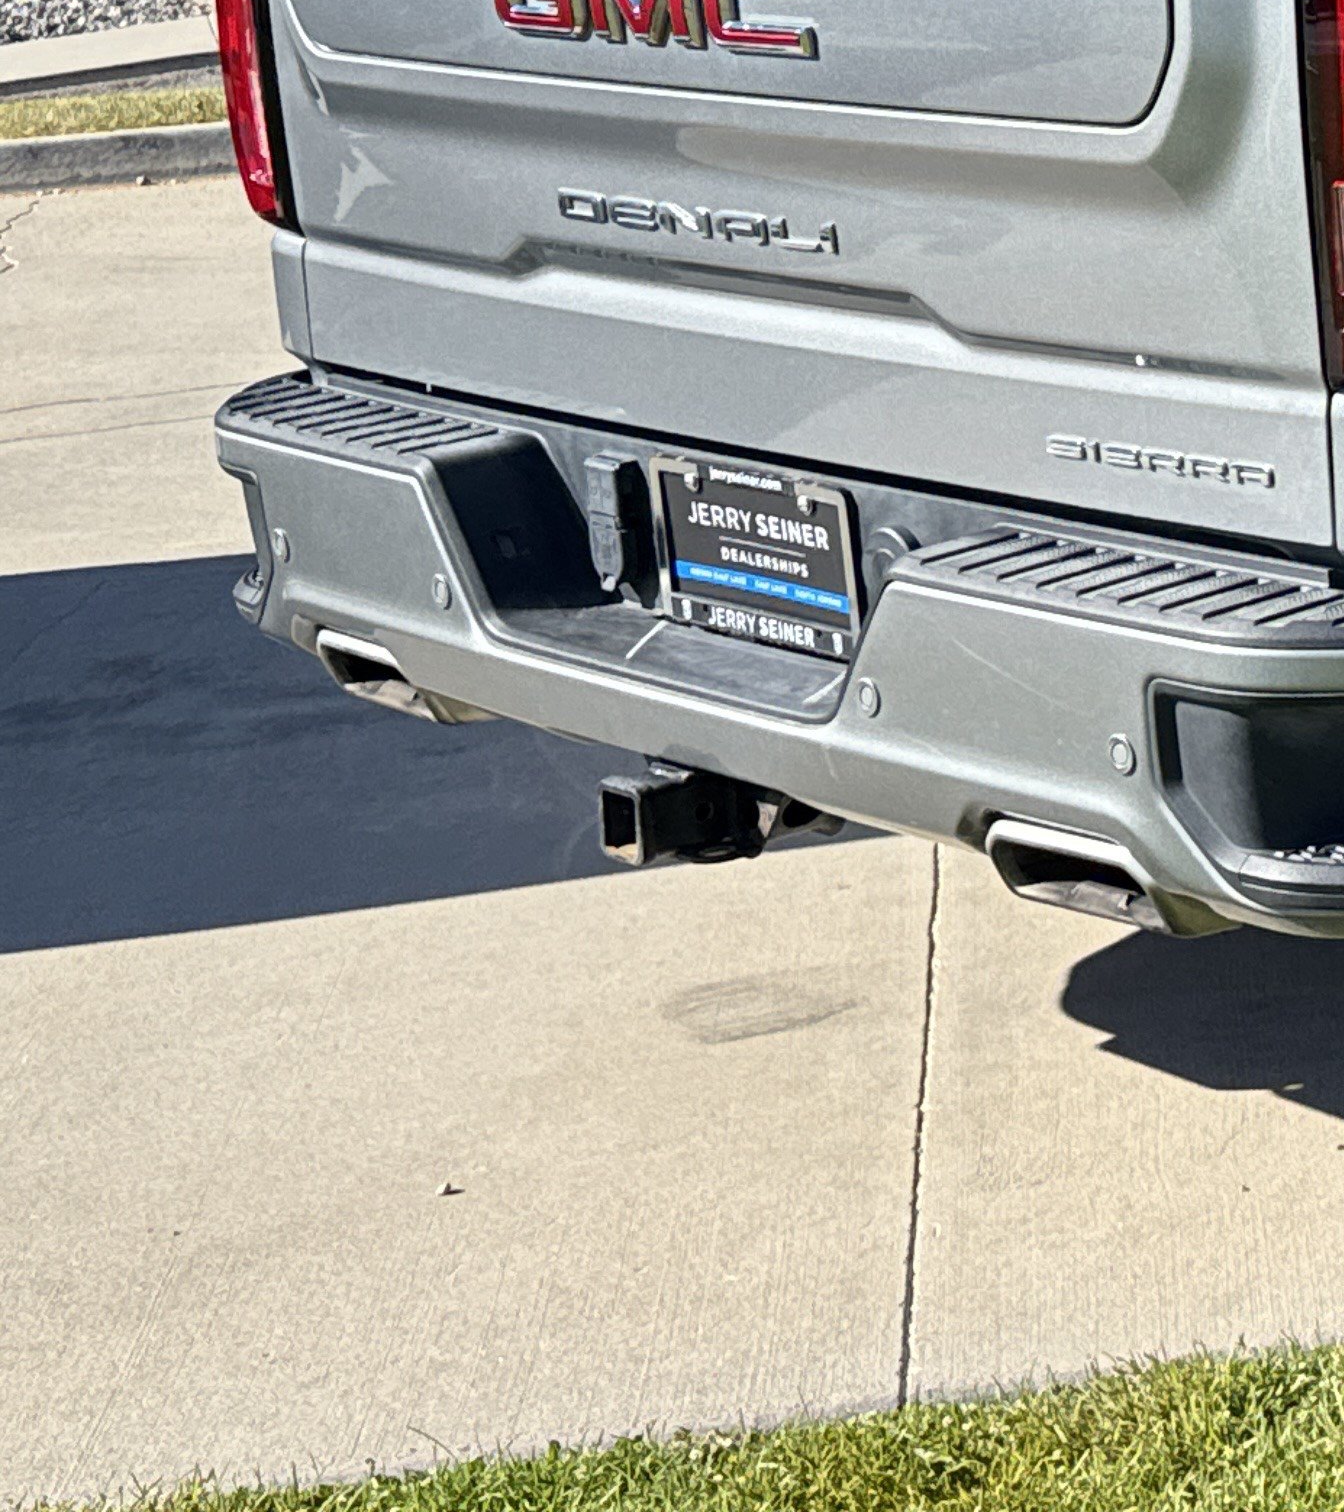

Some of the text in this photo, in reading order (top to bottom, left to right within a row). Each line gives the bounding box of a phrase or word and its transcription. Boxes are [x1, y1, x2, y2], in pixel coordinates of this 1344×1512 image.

[557, 186, 840, 255] DENALI
[1046, 433, 1276, 489] SIERRA
[687, 500, 830, 551] JERRY SEINER
[720, 545, 809, 579] DEALERSHIPS
[708, 605, 815, 649] JERRY SEINER
